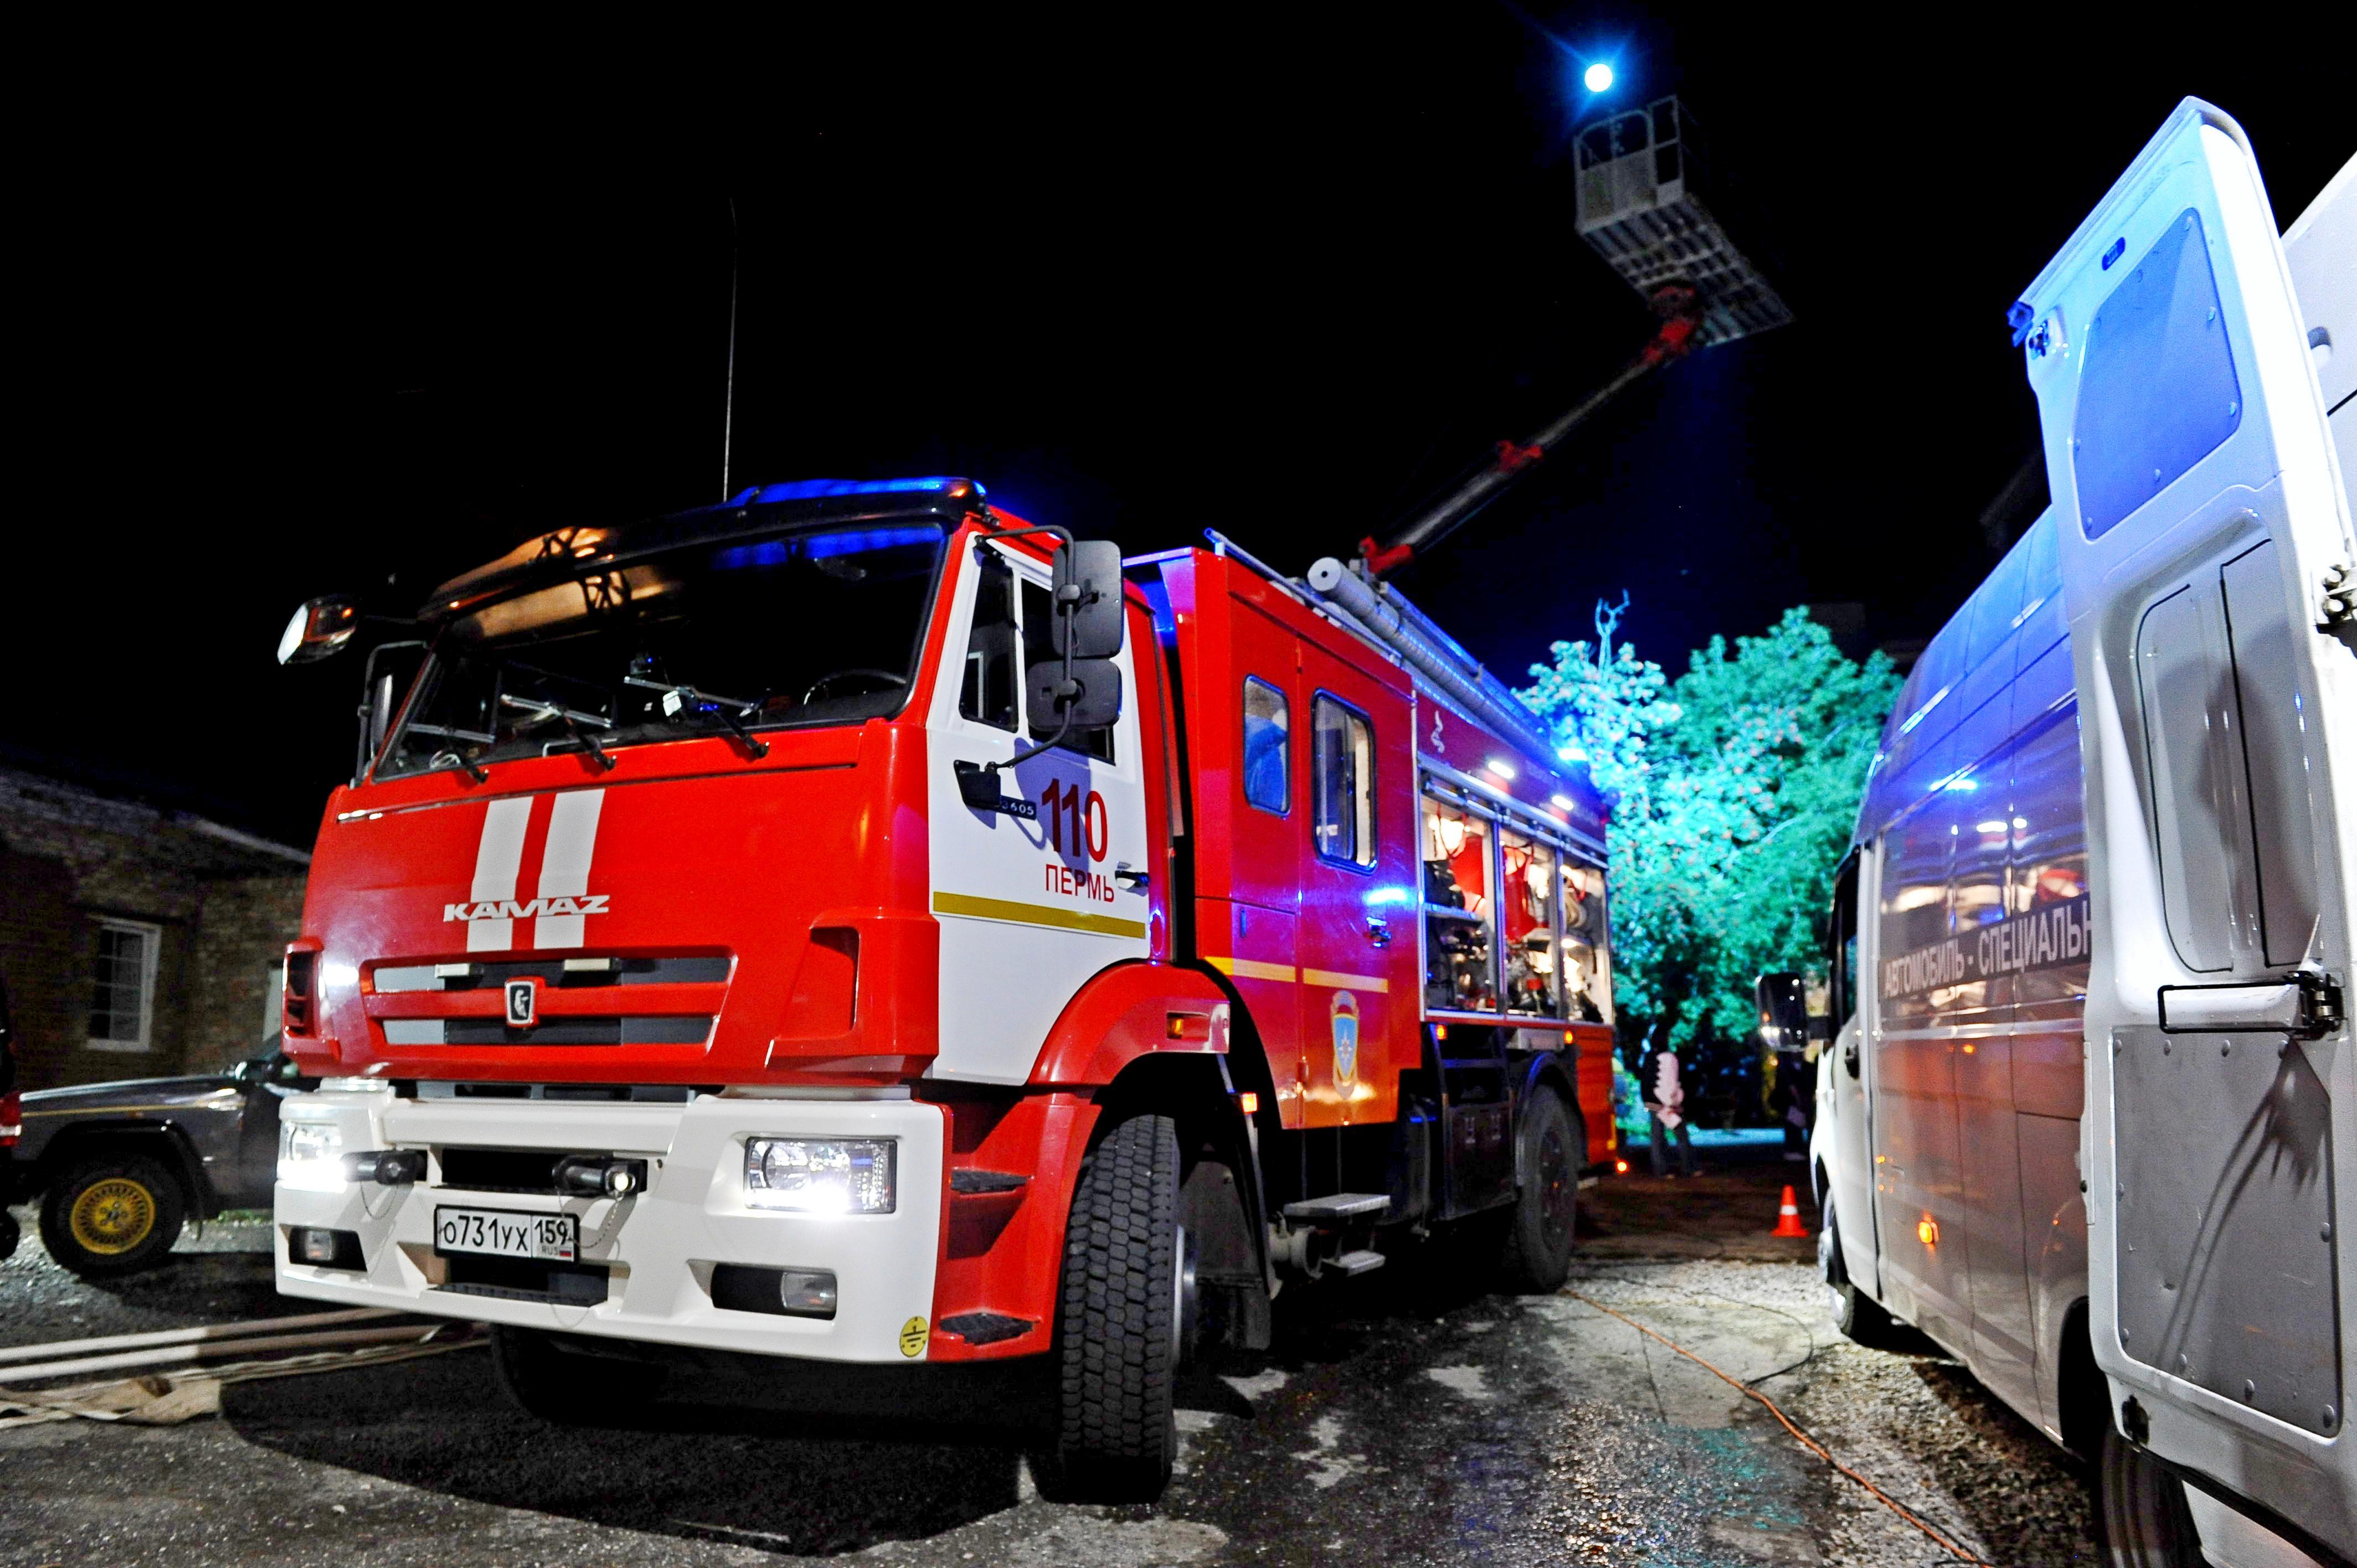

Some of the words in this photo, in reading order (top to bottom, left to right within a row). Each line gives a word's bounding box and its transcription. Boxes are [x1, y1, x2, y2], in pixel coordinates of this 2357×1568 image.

[1042, 778, 1108, 863] 110
[1046, 864, 1114, 902] ПЕРМЬ
[443, 895, 610, 922] KAMAZ
[1883, 938, 1965, 997] АВТОМОБИЛЬ
[534, 1219, 568, 1245] 159
[542, 1246, 559, 1256] RUS
